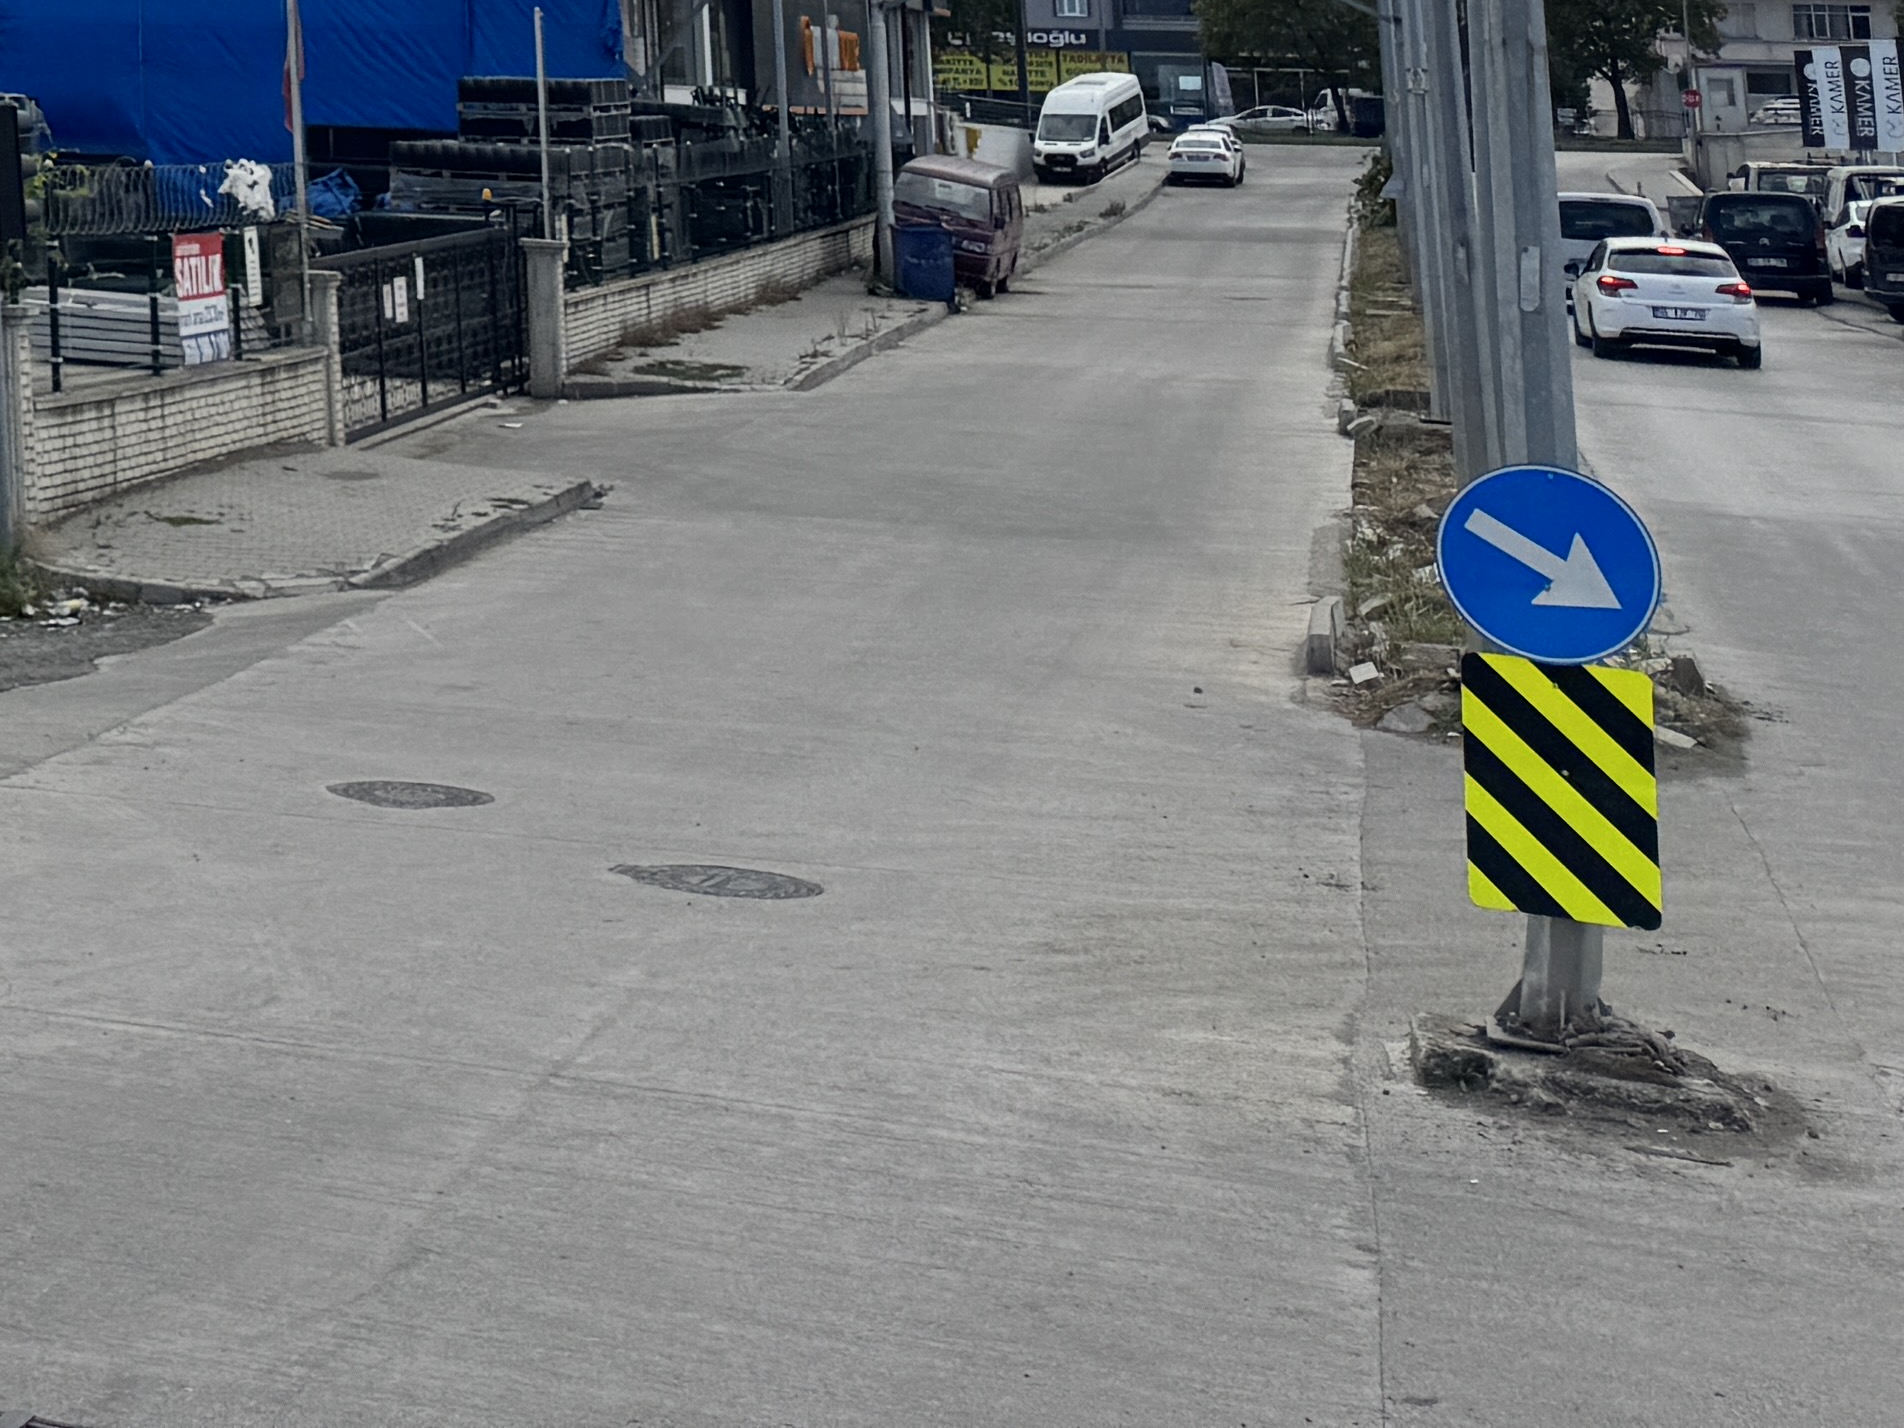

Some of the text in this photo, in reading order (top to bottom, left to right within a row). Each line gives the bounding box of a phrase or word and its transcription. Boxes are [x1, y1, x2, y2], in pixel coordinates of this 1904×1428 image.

[1824, 61, 1845, 114] KAMER
[1854, 80, 1875, 136] KAMER
[1882, 56, 1903, 115] KAMER
